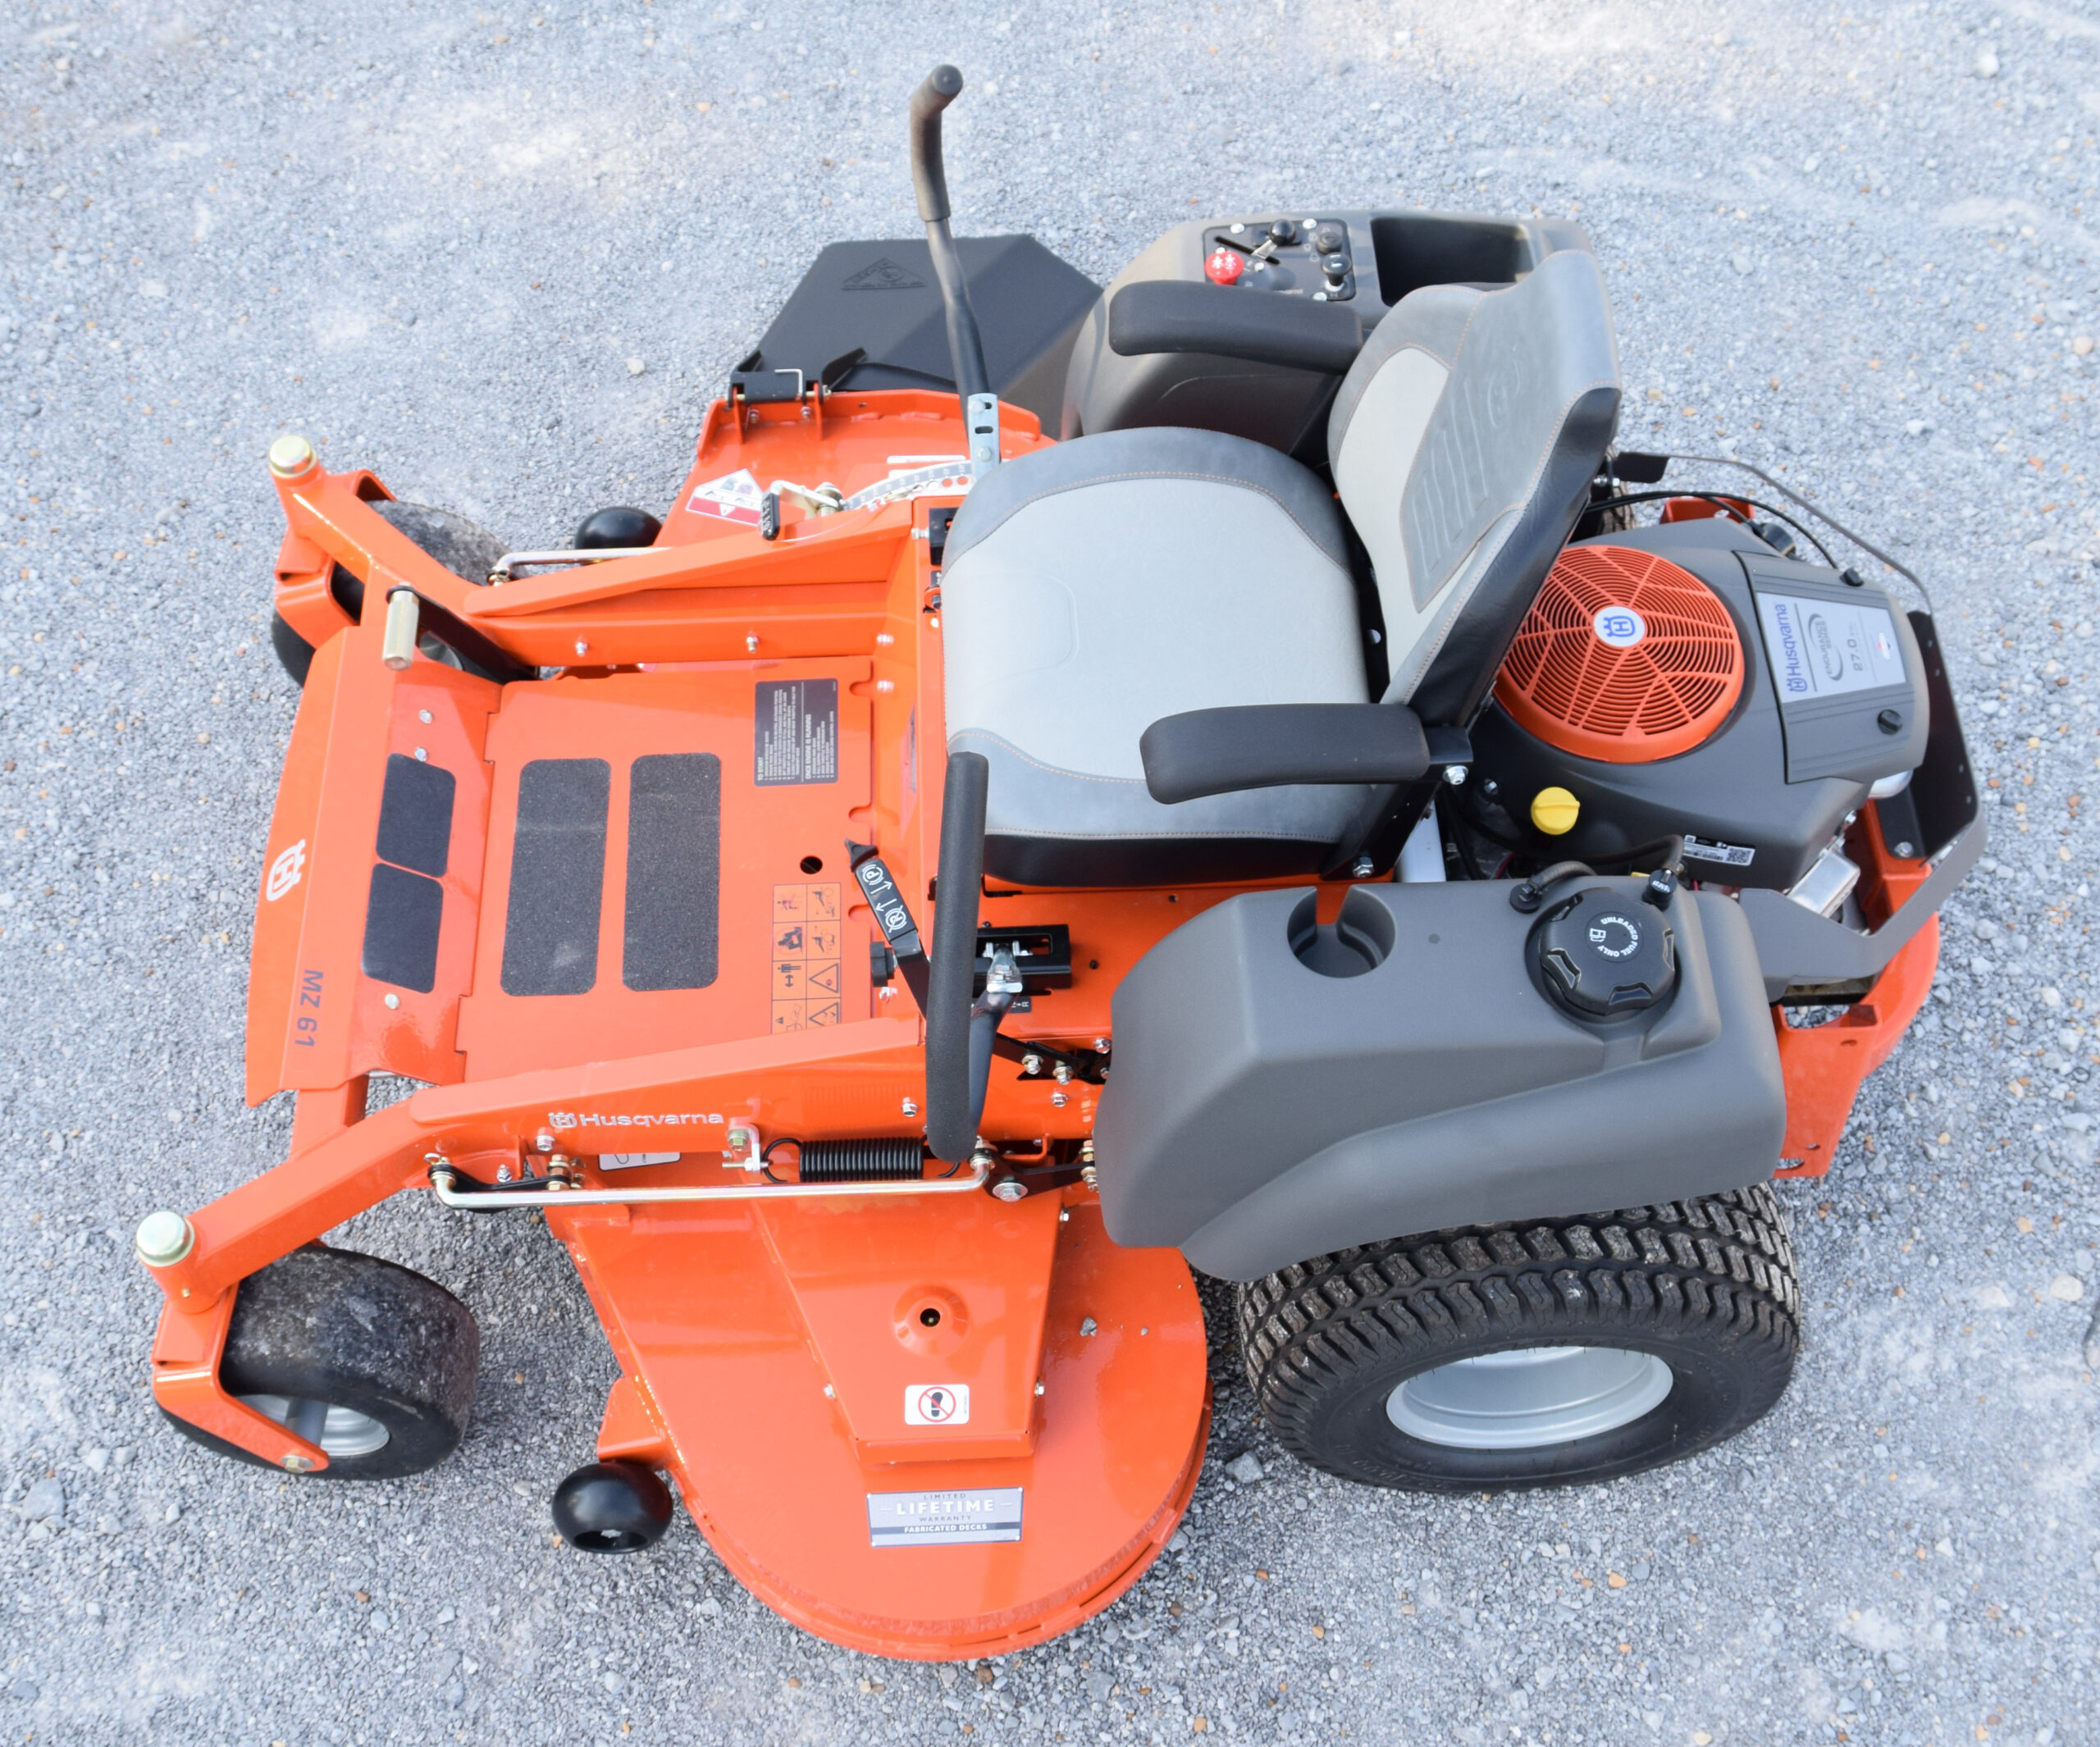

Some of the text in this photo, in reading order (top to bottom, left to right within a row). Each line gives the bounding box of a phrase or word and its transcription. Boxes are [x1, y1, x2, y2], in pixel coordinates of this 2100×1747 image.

[1775, 604, 1801, 676] Husqvarna
[1815, 620, 1833, 675] ENDURANCE
[1847, 639, 1864, 671] 27.0
[1597, 916, 1638, 957] UNLEADED FUEL ONLY
[294, 969, 324, 1047] MZ 61
[579, 1113, 724, 1127] Husqvarna
[896, 1499, 994, 1516] LIFETIME
[919, 1515, 972, 1523] WARRANTY
[904, 1523, 988, 1534] FABRICATED DECKS
